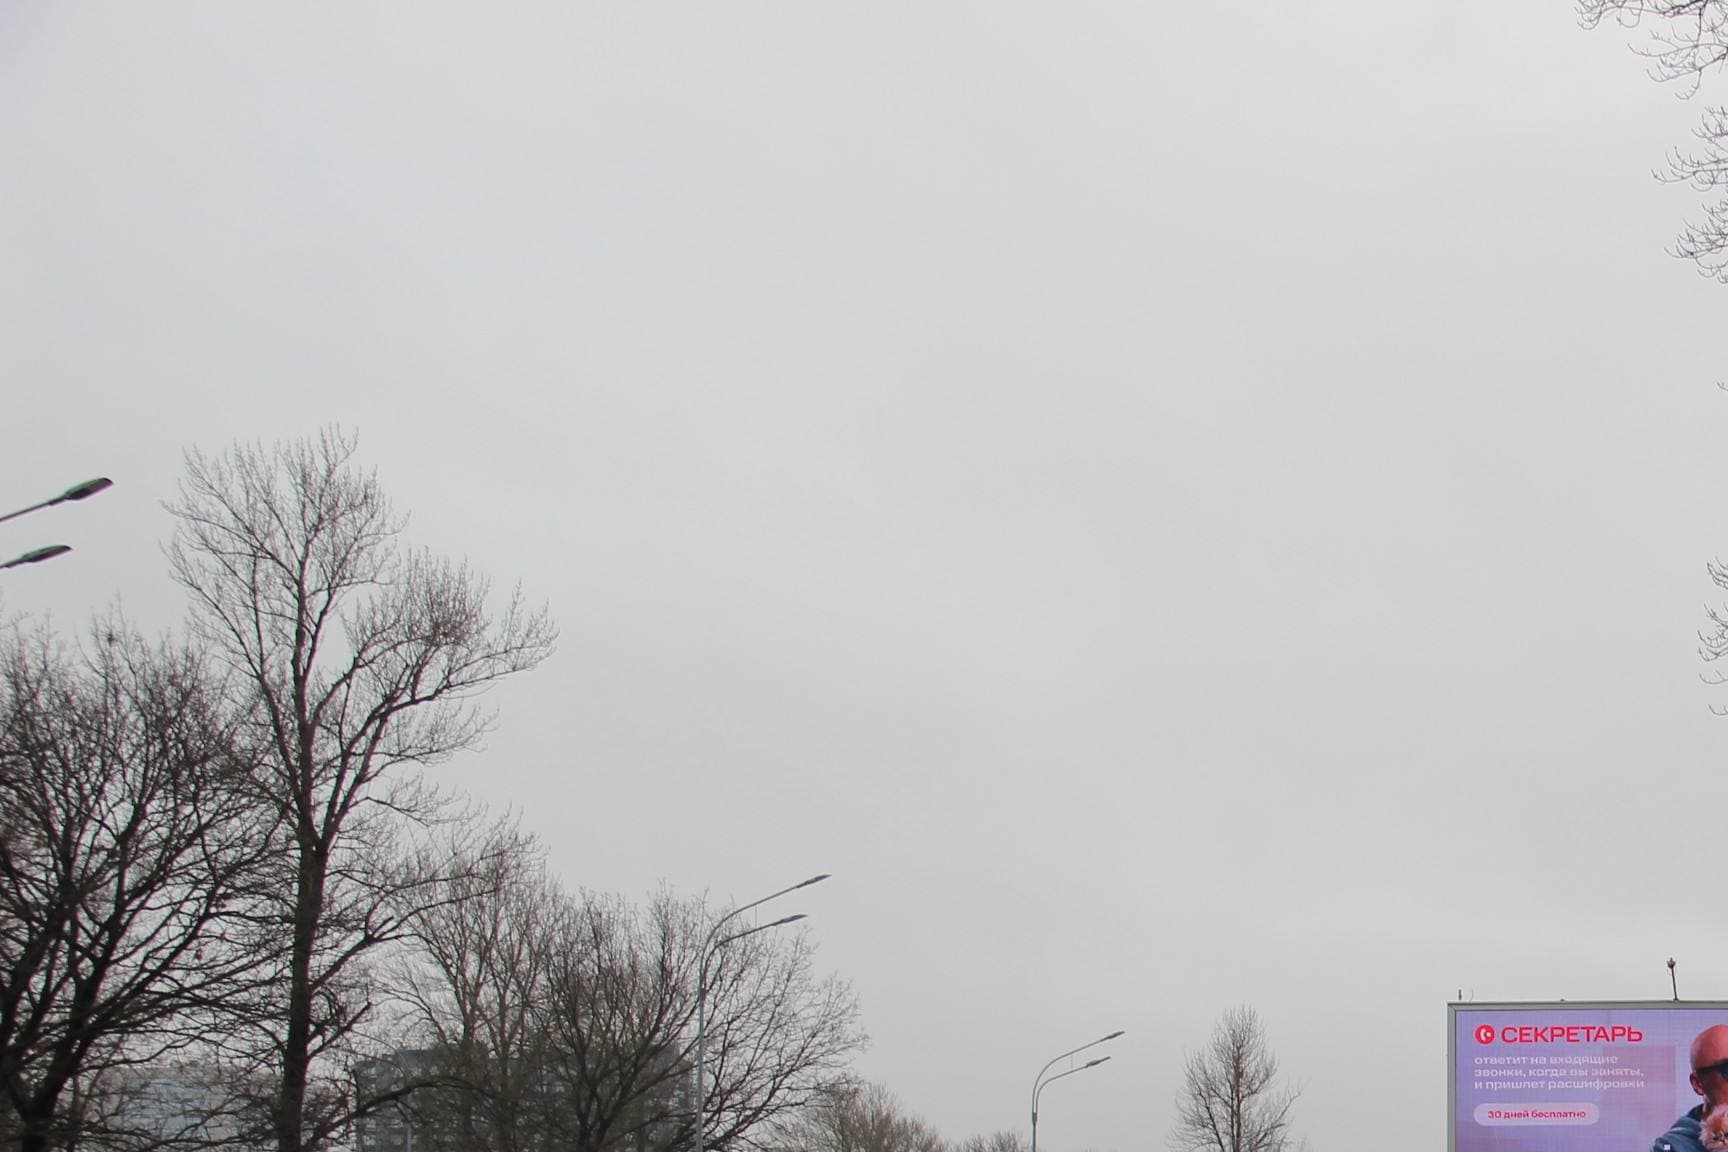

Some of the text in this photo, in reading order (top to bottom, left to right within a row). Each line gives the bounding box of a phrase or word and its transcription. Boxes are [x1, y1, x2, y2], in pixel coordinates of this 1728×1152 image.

[1501, 1026, 1644, 1043] СЕКРЕТАРЬ
[1474, 1055, 1619, 1066] ответит на входящие
[1474, 1067, 1645, 1078] звонки, когда вы заняты,
[1474, 1078, 1645, 1091] и пришлет расшифровки
[1504, 1109, 1529, 1120] дней
[1531, 1110, 1586, 1119] бесплатно
